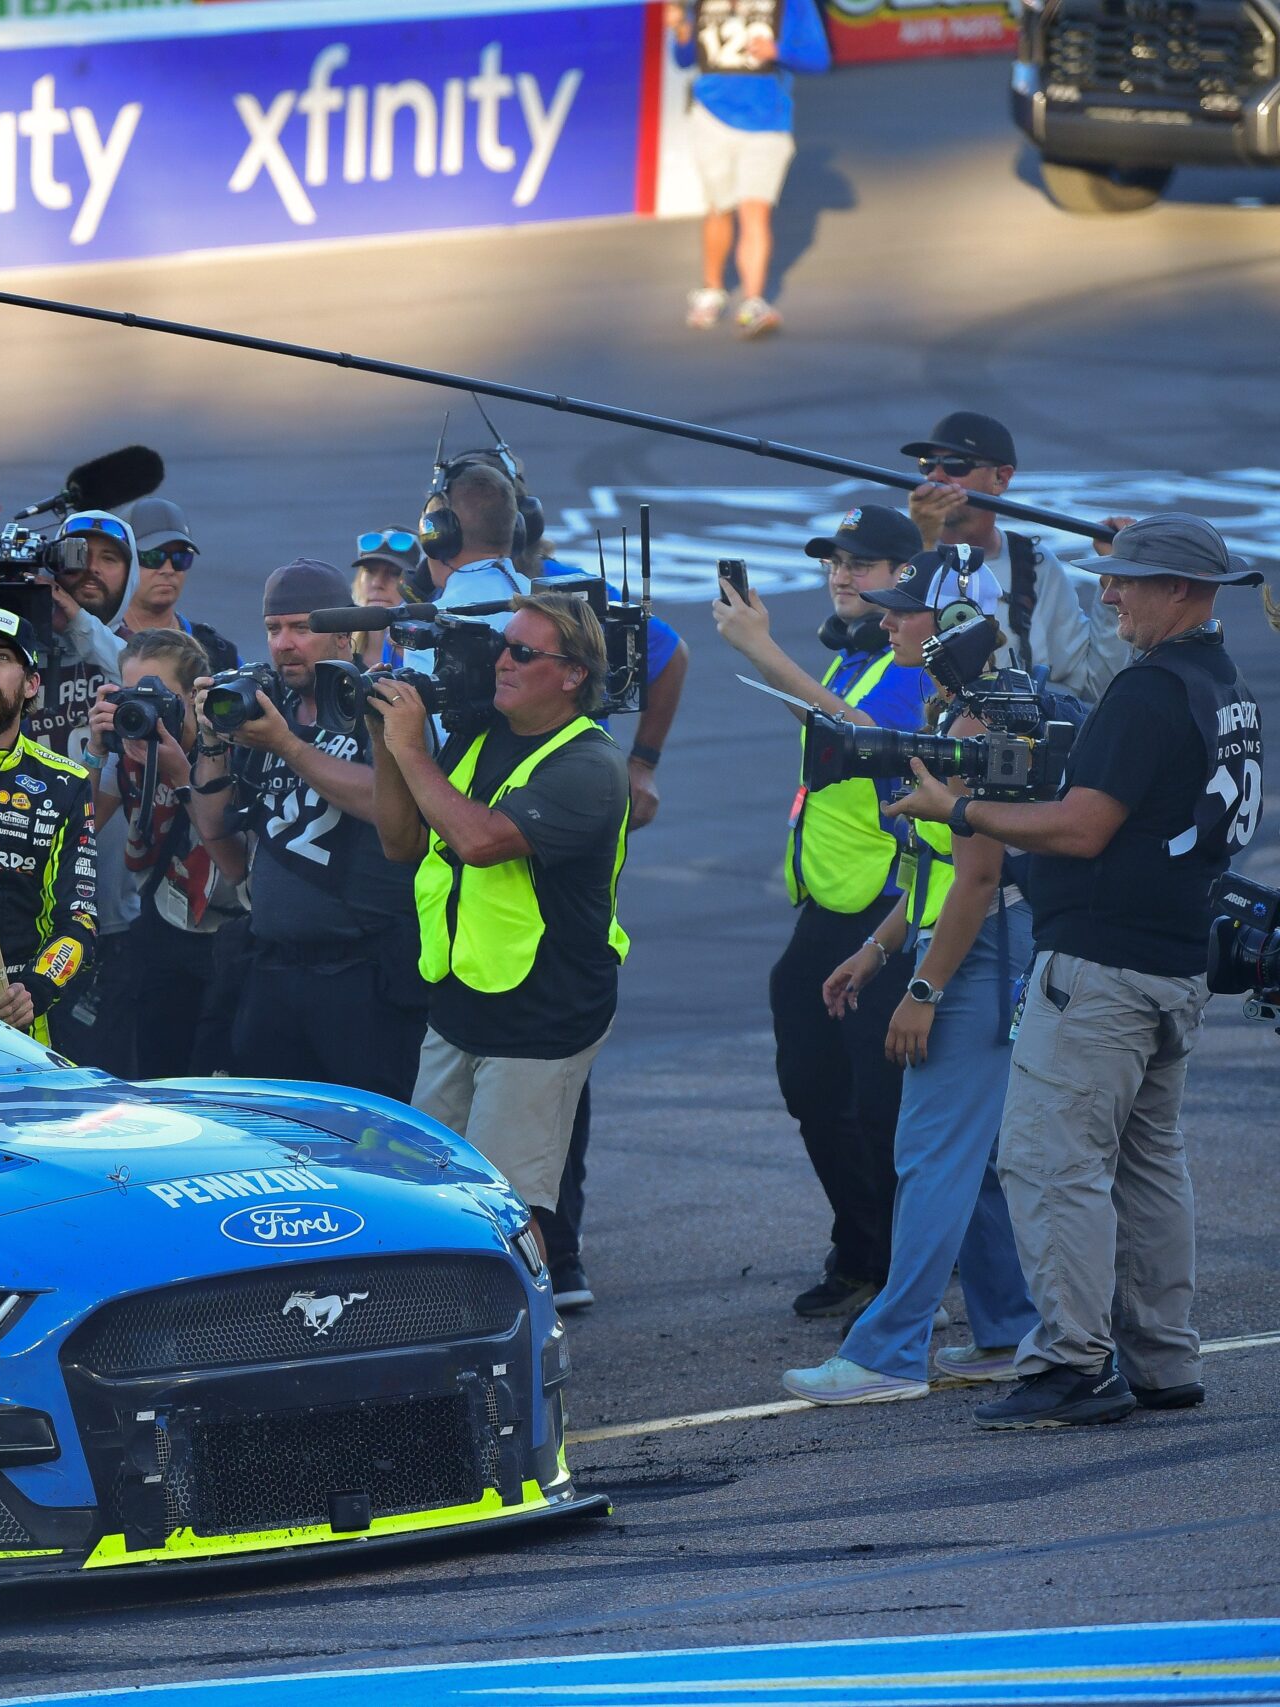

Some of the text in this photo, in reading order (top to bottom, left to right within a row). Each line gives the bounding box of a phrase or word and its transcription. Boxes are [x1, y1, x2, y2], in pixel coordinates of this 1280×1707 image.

[228, 41, 584, 225] xfinity
[20, 776, 40, 792] Ford
[32, 837, 52, 847] MOE
[1224, 892, 1247, 908] ARRI
[4, 964, 27, 974] NEY
[147, 1164, 339, 1209] PENNZOIL
[253, 1207, 340, 1241] Ford
